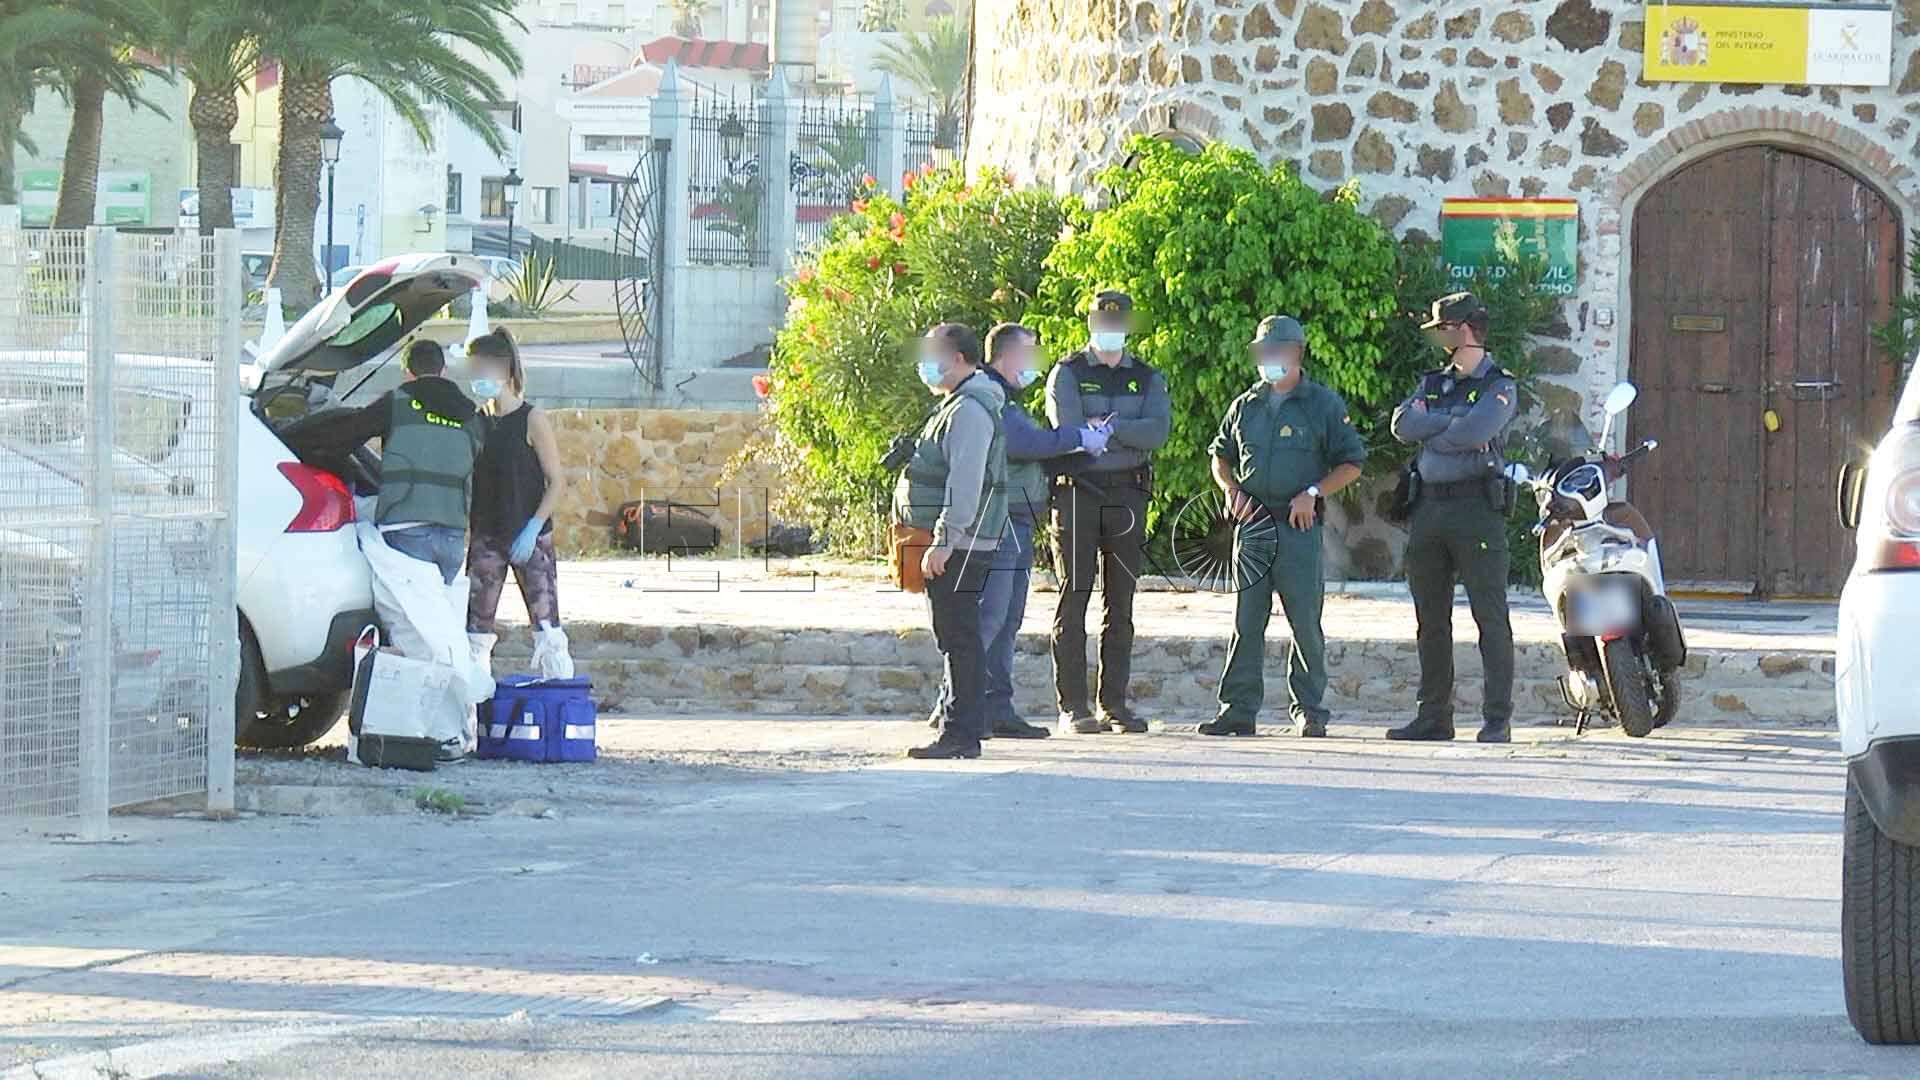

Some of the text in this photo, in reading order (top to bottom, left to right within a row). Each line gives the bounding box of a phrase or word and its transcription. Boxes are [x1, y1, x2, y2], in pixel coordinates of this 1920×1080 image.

[1715, 31, 1764, 39] MINISTERIO
[1715, 41, 1774, 49] DEL INTERIOR
